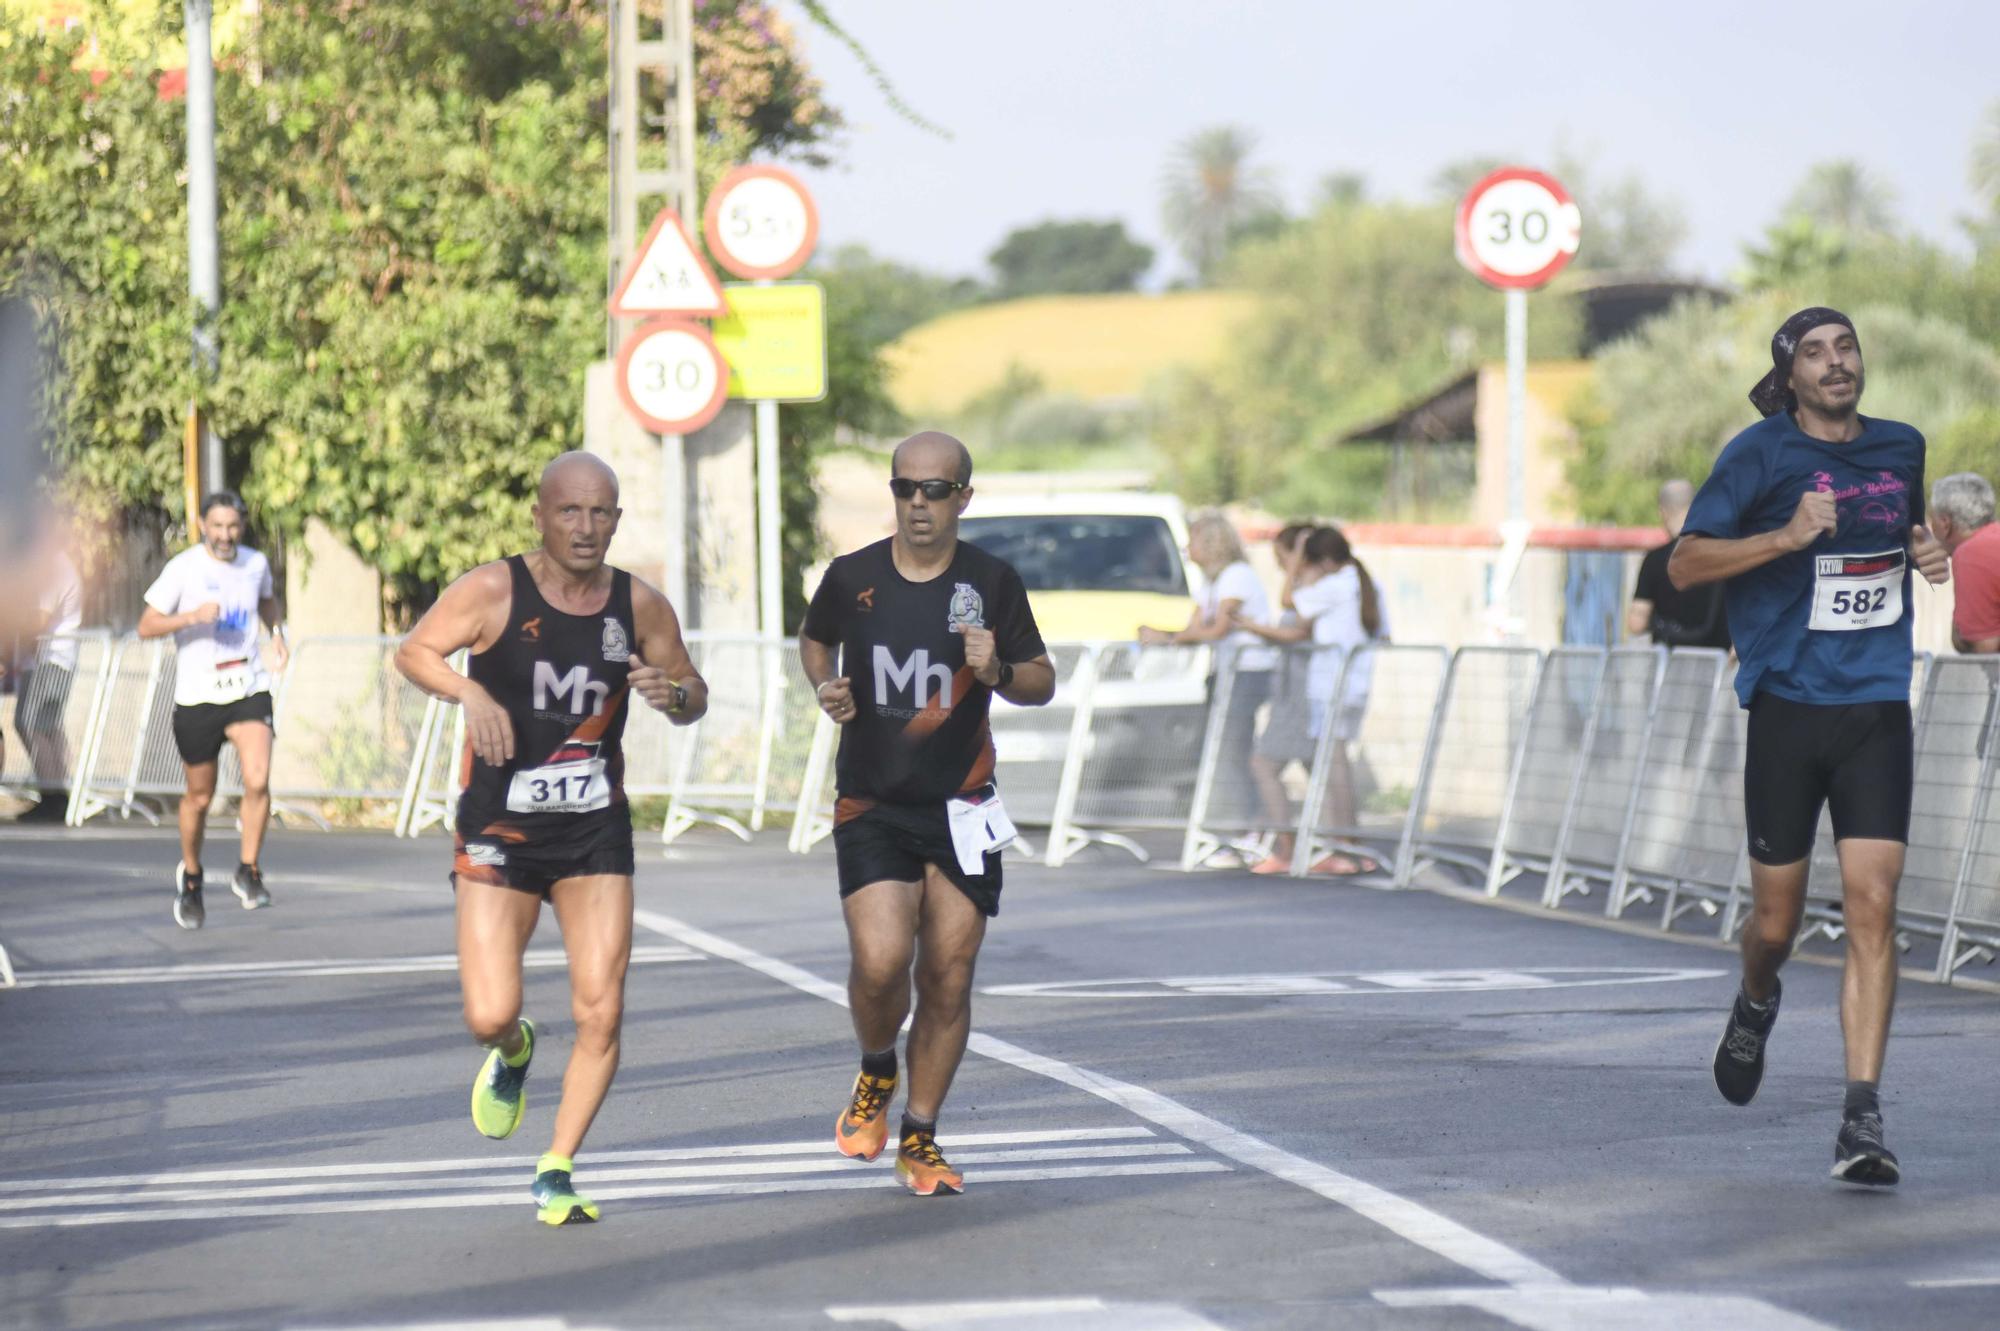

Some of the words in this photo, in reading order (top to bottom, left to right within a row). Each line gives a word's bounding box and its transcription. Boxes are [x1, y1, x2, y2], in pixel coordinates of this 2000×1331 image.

[1488, 210, 1548, 244] 30
[645, 360, 700, 391] 30
[1832, 587, 1887, 615] 582
[533, 661, 609, 717] Mh
[873, 645, 952, 709] Mh
[530, 775, 592, 803] 317
